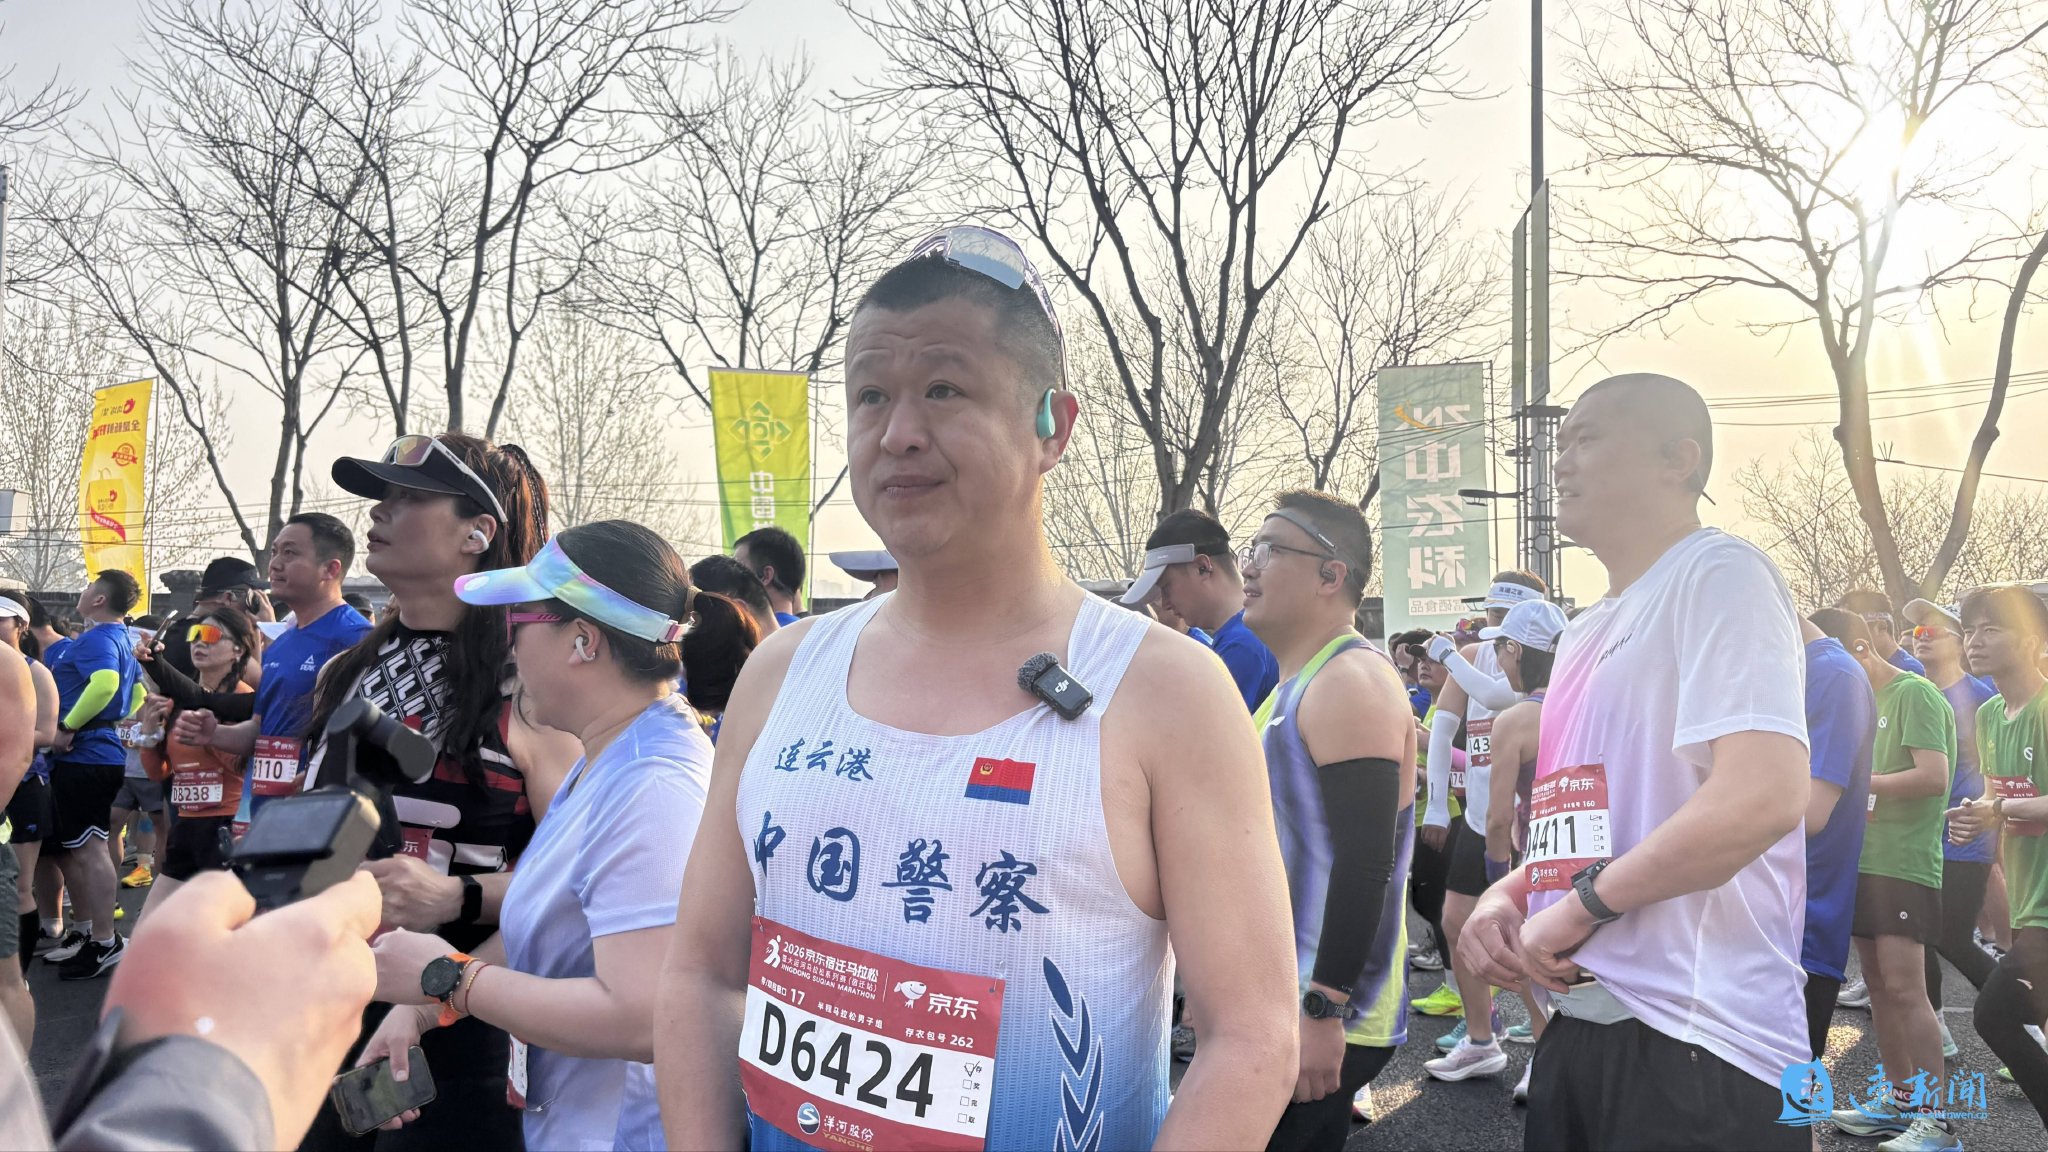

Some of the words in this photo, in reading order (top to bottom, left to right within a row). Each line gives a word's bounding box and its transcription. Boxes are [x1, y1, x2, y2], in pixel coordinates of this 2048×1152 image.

[1470, 737, 1490, 753] 43
[774, 737, 874, 782] 连云港
[173, 787, 210, 801] D8238
[1570, 778, 1595, 791] 京东
[753, 810, 1050, 934] 中国警察
[783, 941, 879, 983] 2026京东宿迁马拉松
[812, 975, 835, 989] SUQIAN
[837, 984, 876, 1000] MARATHON
[790, 988, 806, 1005] 17
[817, 1001, 883, 1029] 半程马拉松男子组
[905, 1027, 946, 1043] 存衣包号
[950, 1034, 974, 1048] 262
[927, 993, 979, 1020] 京东
[759, 1000, 934, 1119] D6424
[822, 1132, 874, 1152] YANGHE
[823, 1115, 874, 1143] 洋河股份
